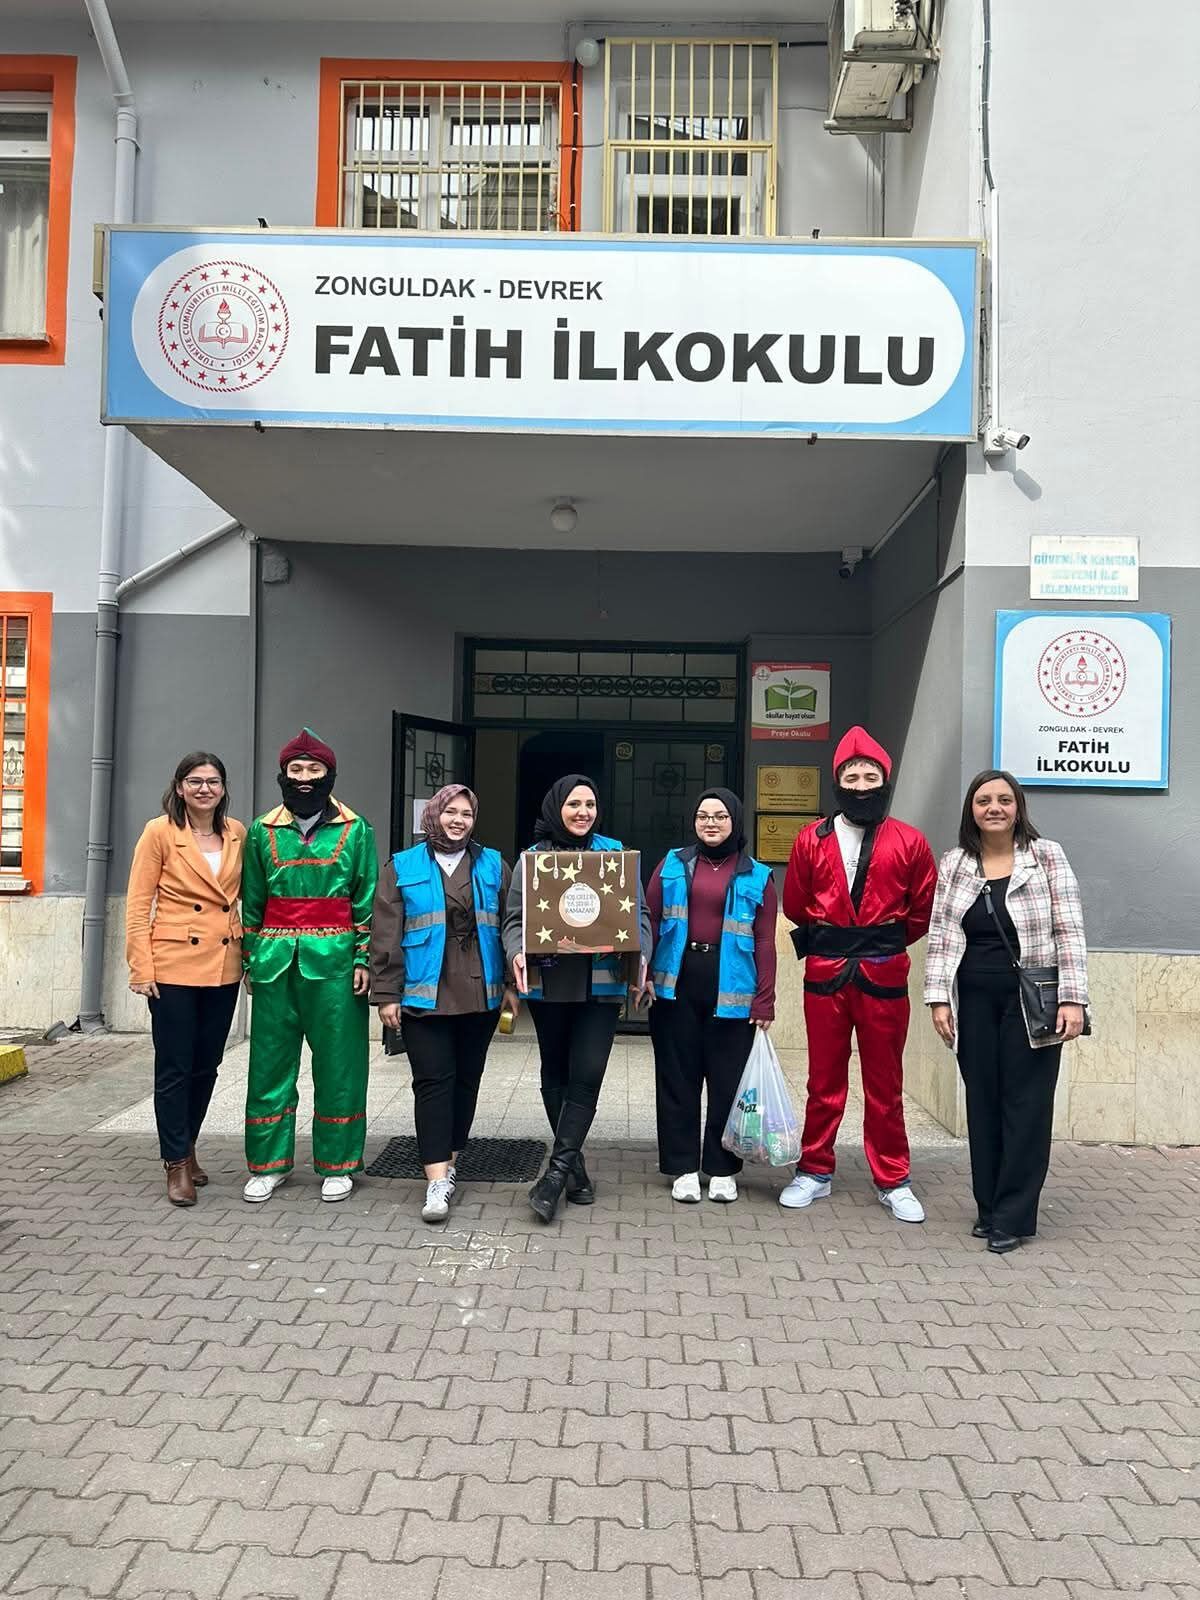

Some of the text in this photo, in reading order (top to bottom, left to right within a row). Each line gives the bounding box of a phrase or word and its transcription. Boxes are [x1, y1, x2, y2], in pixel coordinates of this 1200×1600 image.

[221, 284, 247, 297] MİLLİ
[314, 275, 476, 299] ZONGULDAK
[499, 279, 603, 301] DEVREK
[314, 315, 935, 386] FATİH İLKOKULU
[771, 730, 811, 739] Proje Okulu
[1038, 725, 1087, 733] ZONGULDAK
[1092, 726, 1124, 734] DEVREK
[1058, 738, 1110, 754] FATİH
[1036, 756, 1130, 773] İLKOKULU
